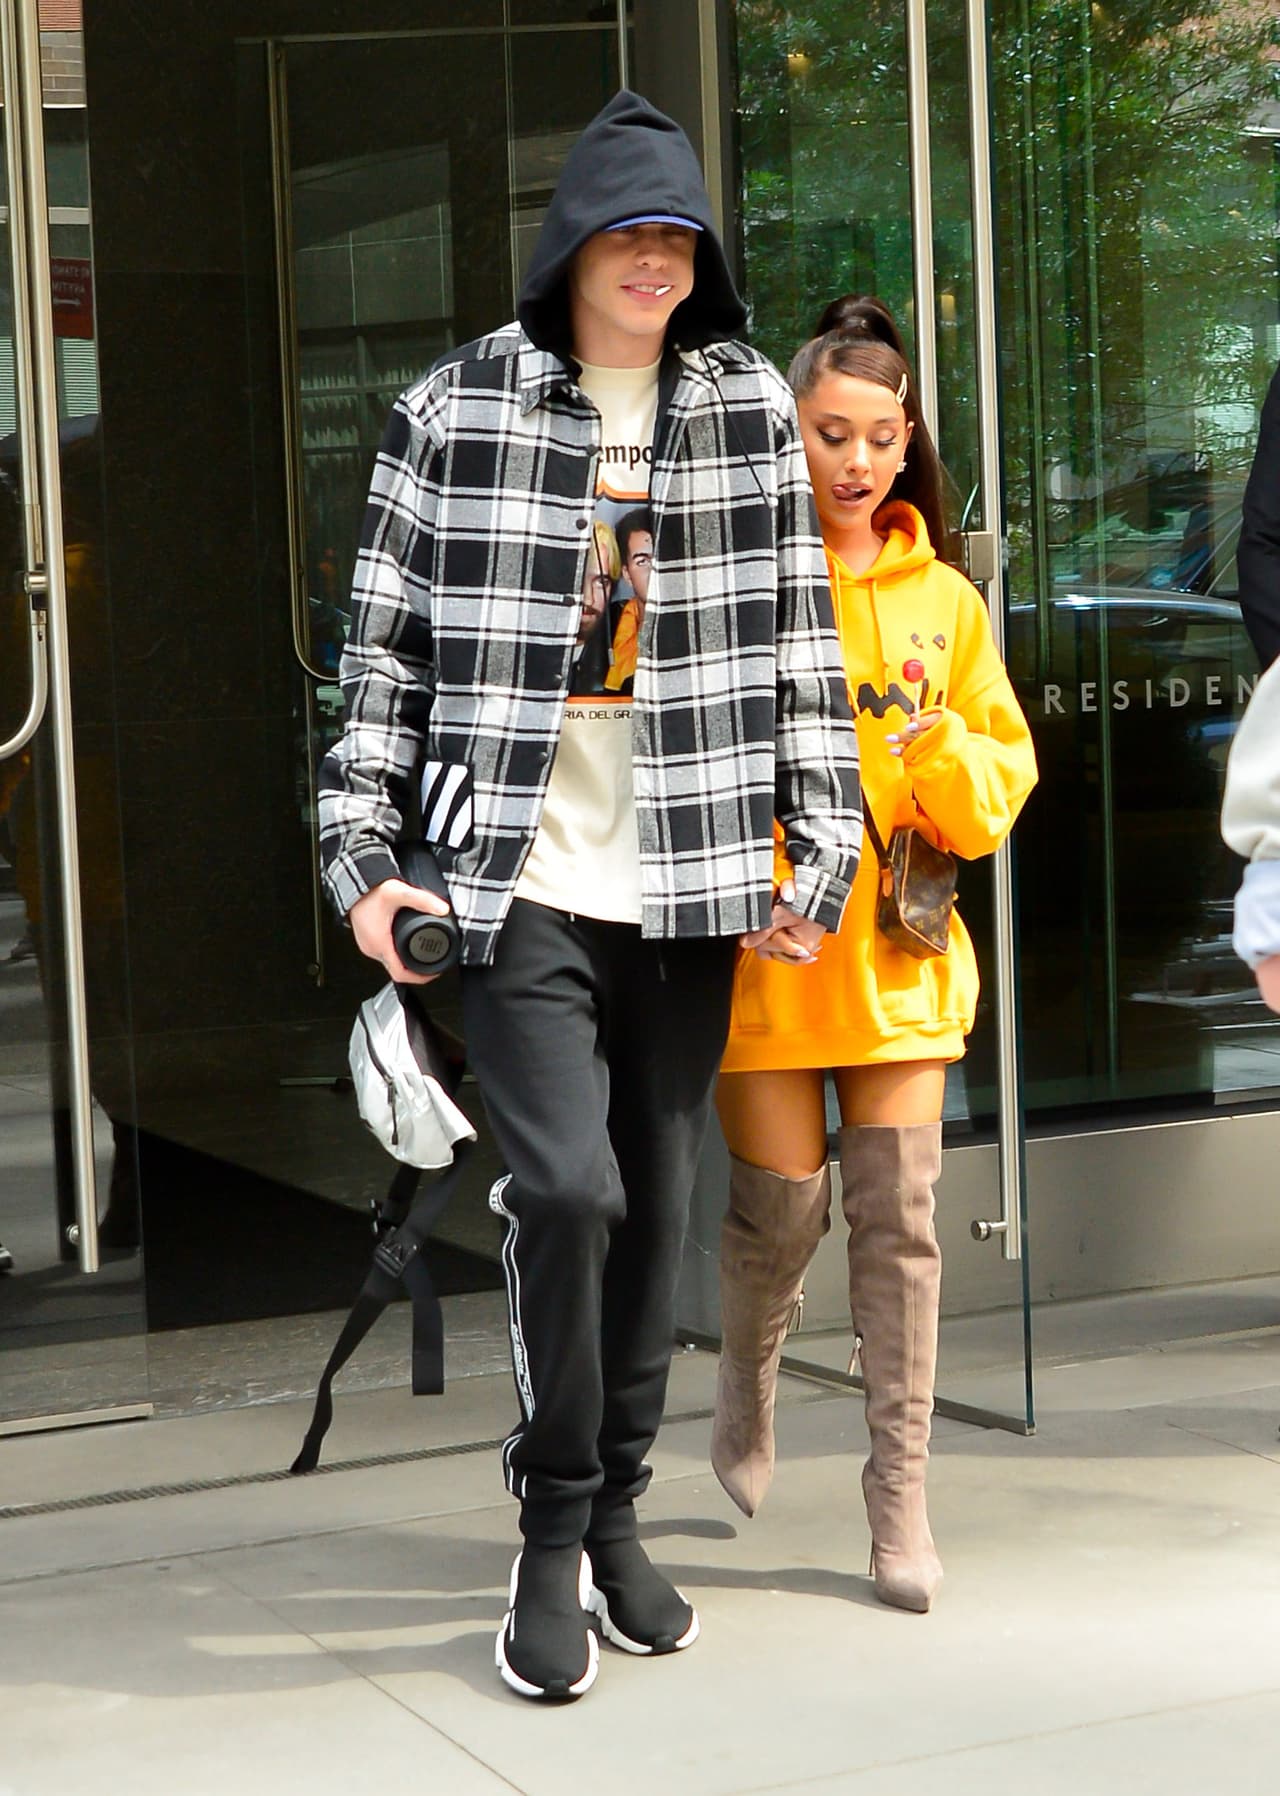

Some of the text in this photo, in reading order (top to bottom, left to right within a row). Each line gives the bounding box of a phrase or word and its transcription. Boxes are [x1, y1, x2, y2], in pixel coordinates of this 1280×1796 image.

[1043, 673, 1259, 715] RESIDEN
[588, 709, 611, 720] DEL
[613, 708, 633, 720] GR
